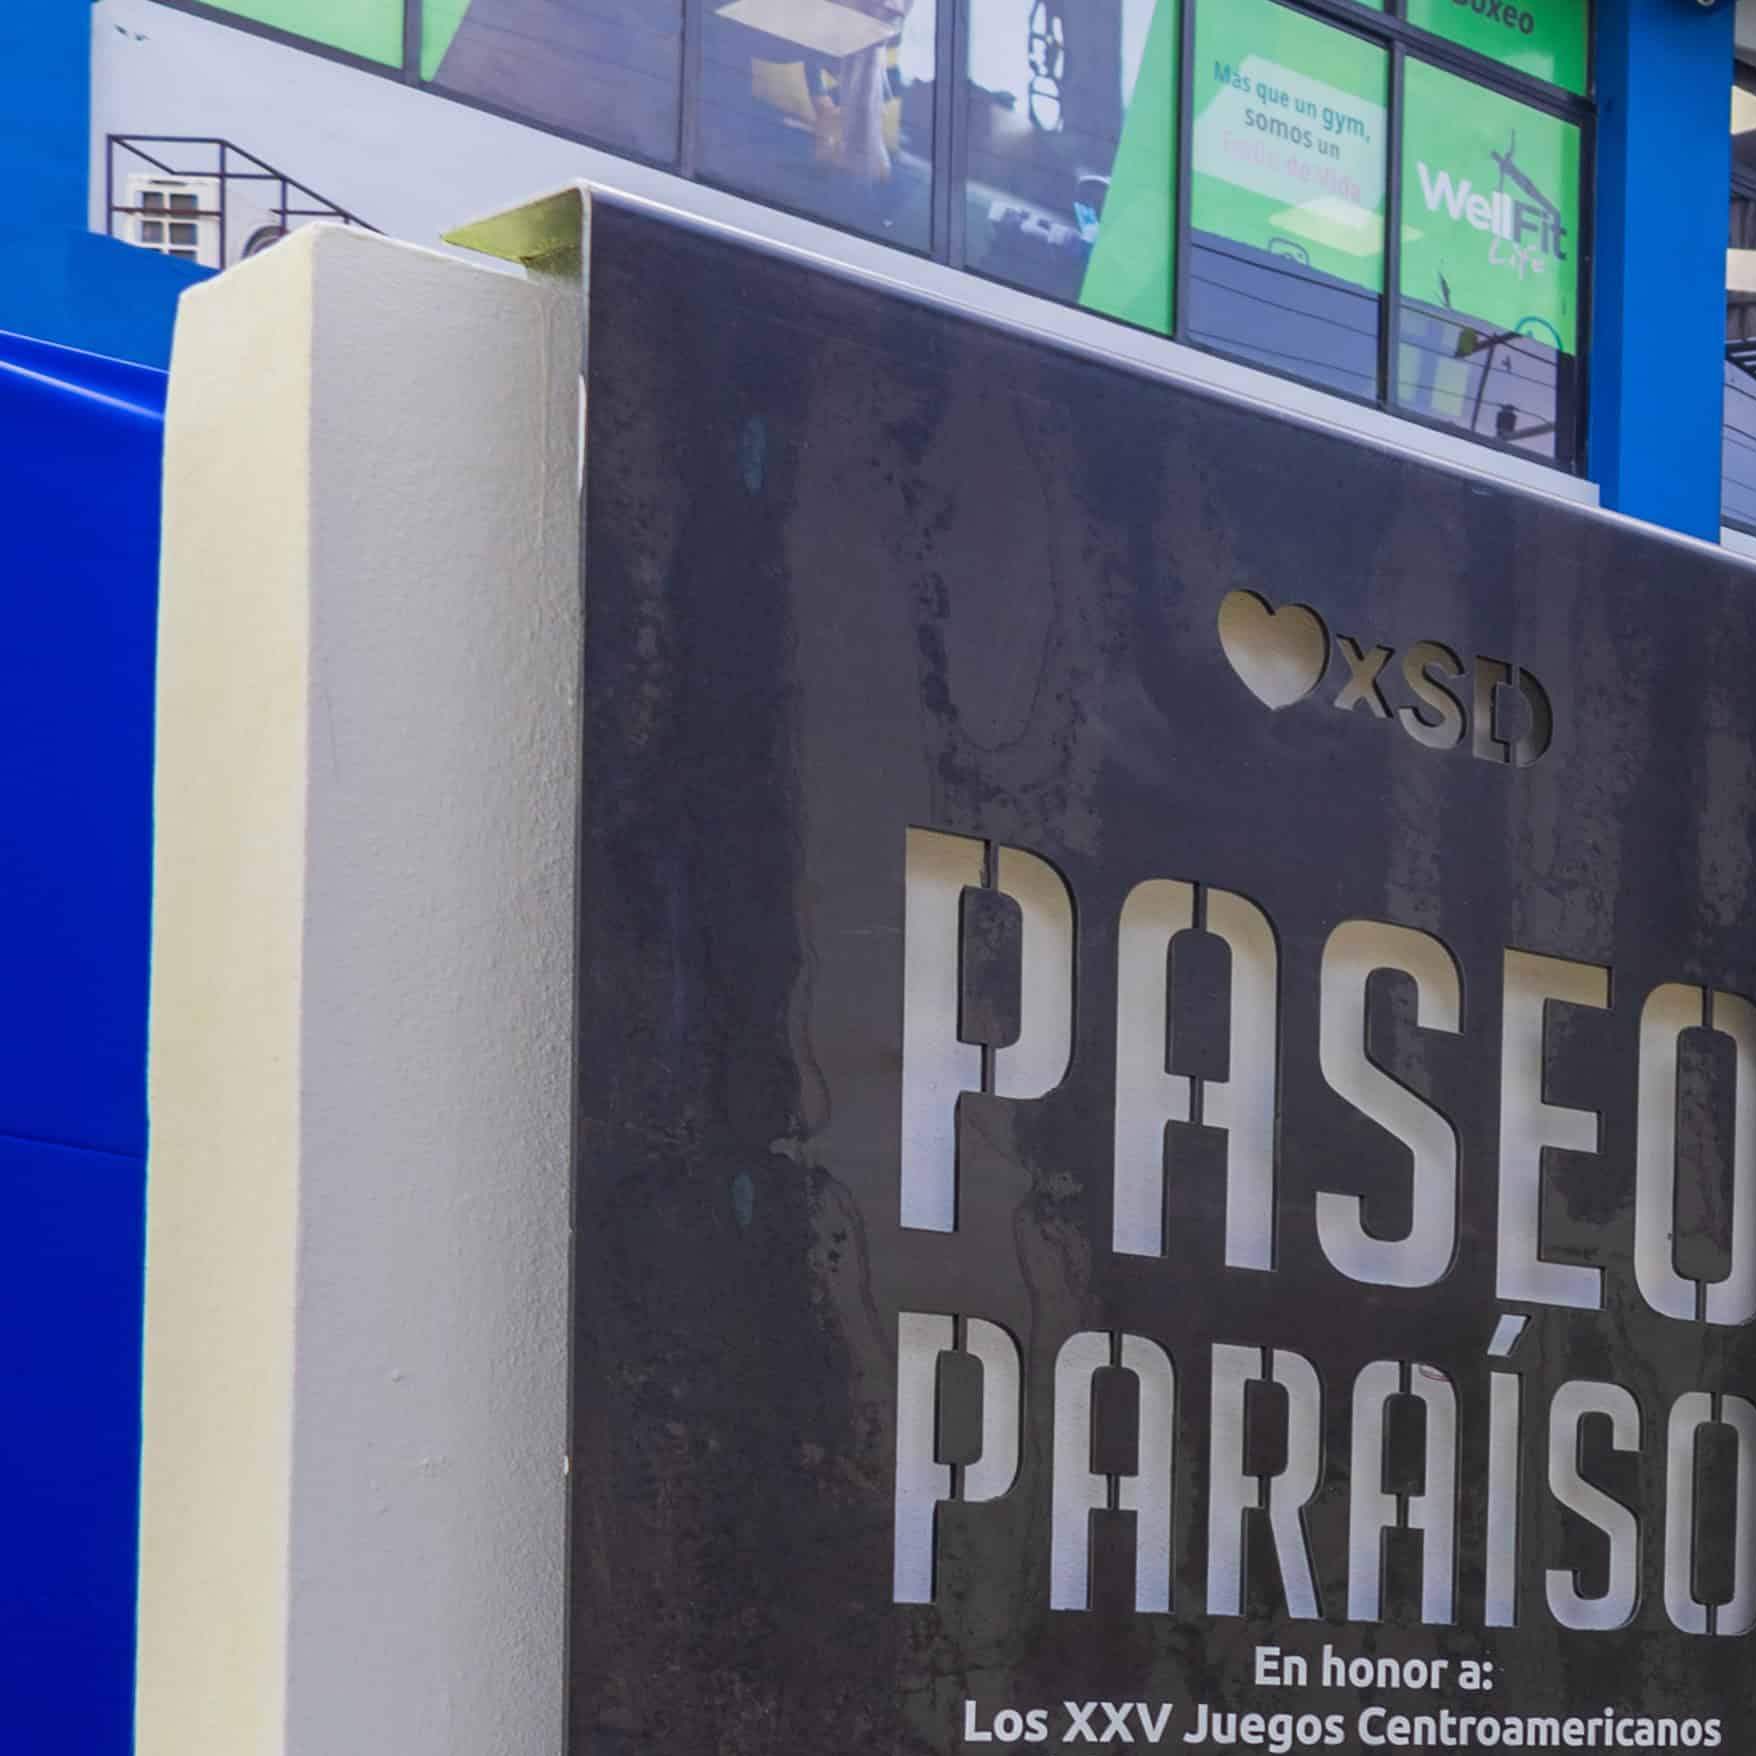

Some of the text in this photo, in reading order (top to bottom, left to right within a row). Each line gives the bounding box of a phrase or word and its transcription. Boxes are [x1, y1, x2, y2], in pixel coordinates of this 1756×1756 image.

[1452, 0, 1534, 35] oxeo
[1213, 61, 1371, 144] Mas que un gym,
[1244, 108, 1340, 160] somos un
[1416, 160, 1567, 261] WellFit
[1488, 238, 1544, 280] Life
[1333, 632, 1553, 768] xSD
[1253, 1644, 1495, 1690] En honor a:
[963, 1699, 1723, 1754] Los XXV Juegos Centroamericanos
